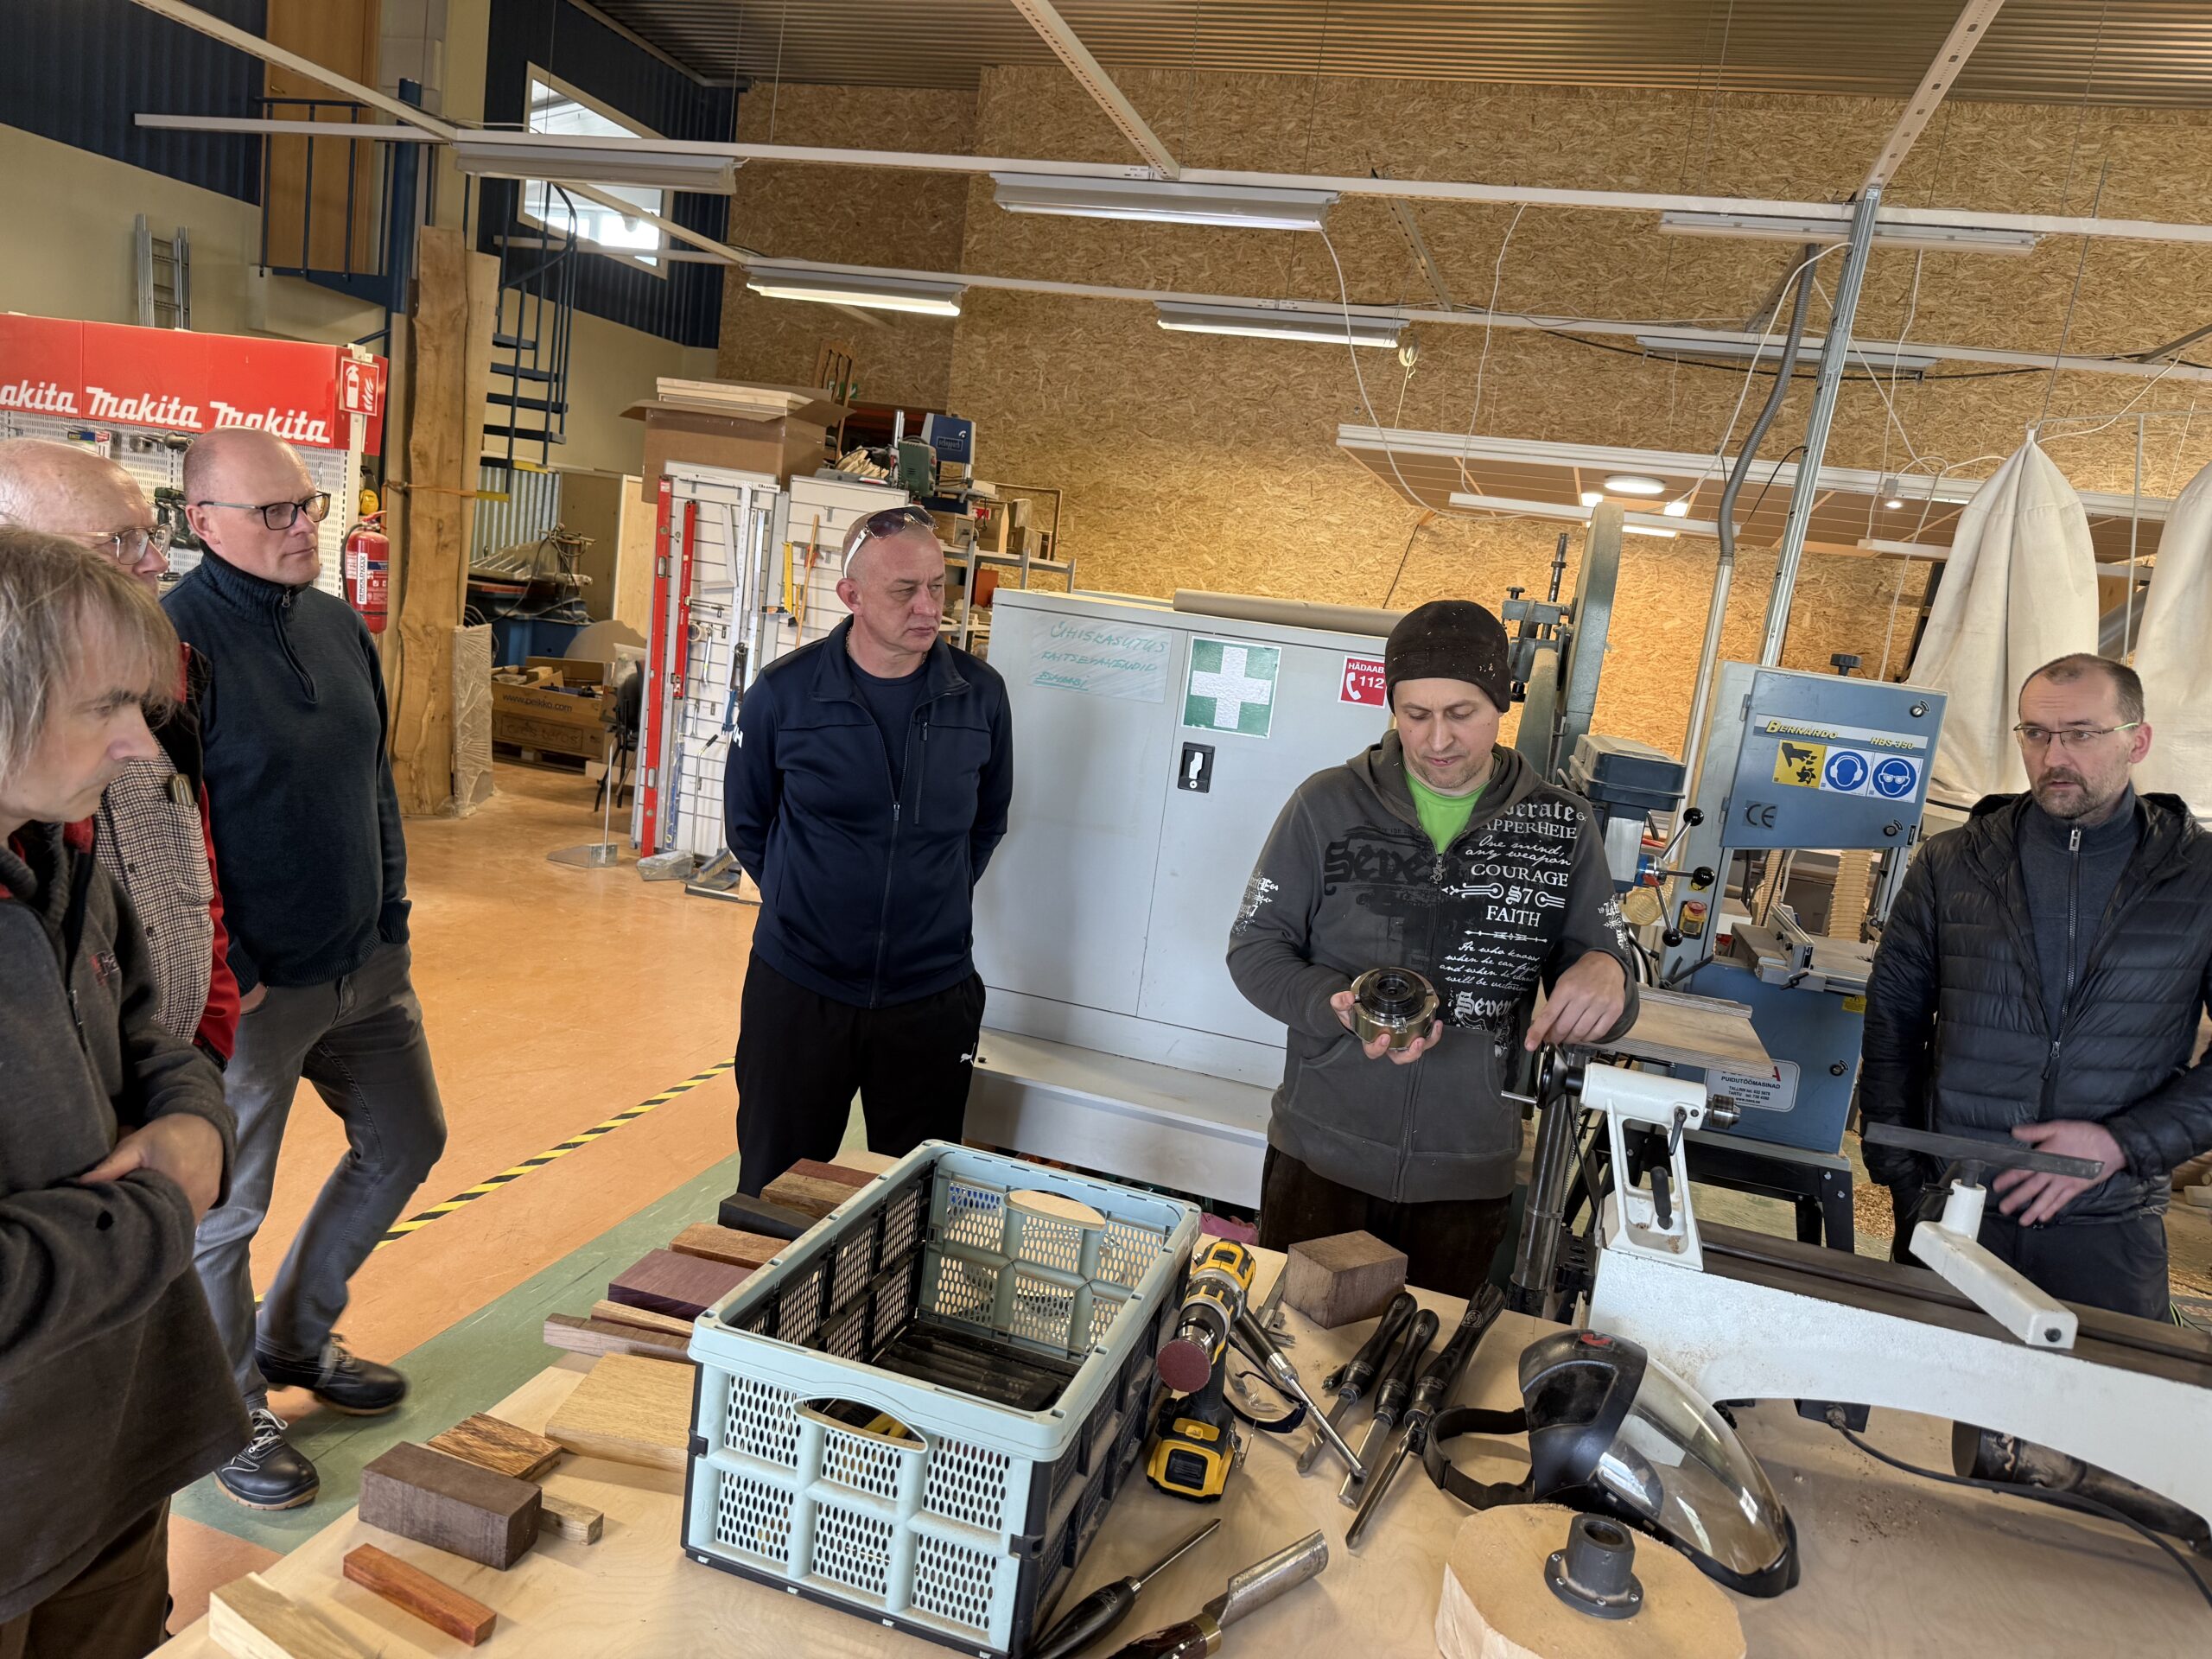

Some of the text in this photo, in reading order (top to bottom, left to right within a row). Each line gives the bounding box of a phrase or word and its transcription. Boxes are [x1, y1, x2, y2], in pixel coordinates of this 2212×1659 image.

[0, 379, 79, 414] akita
[86, 385, 203, 429] Makita
[1348, 661, 1385, 674] HÄDAAB
[1359, 675, 1385, 690] 112
[1765, 720, 1840, 740] BERNARDO
[1478, 835, 1506, 848] One
[1465, 849, 1572, 867] any weapon
[1471, 863, 1569, 887] COURAGE
[1485, 905, 1541, 928] FAITH
[1478, 946, 1506, 955] who
[1444, 954, 1478, 963] when
[1481, 956, 1495, 965] he
[1439, 964, 1465, 973] and
[1465, 966, 1498, 976] when
[1445, 974, 1476, 984] will
[1476, 977, 1488, 986] be
